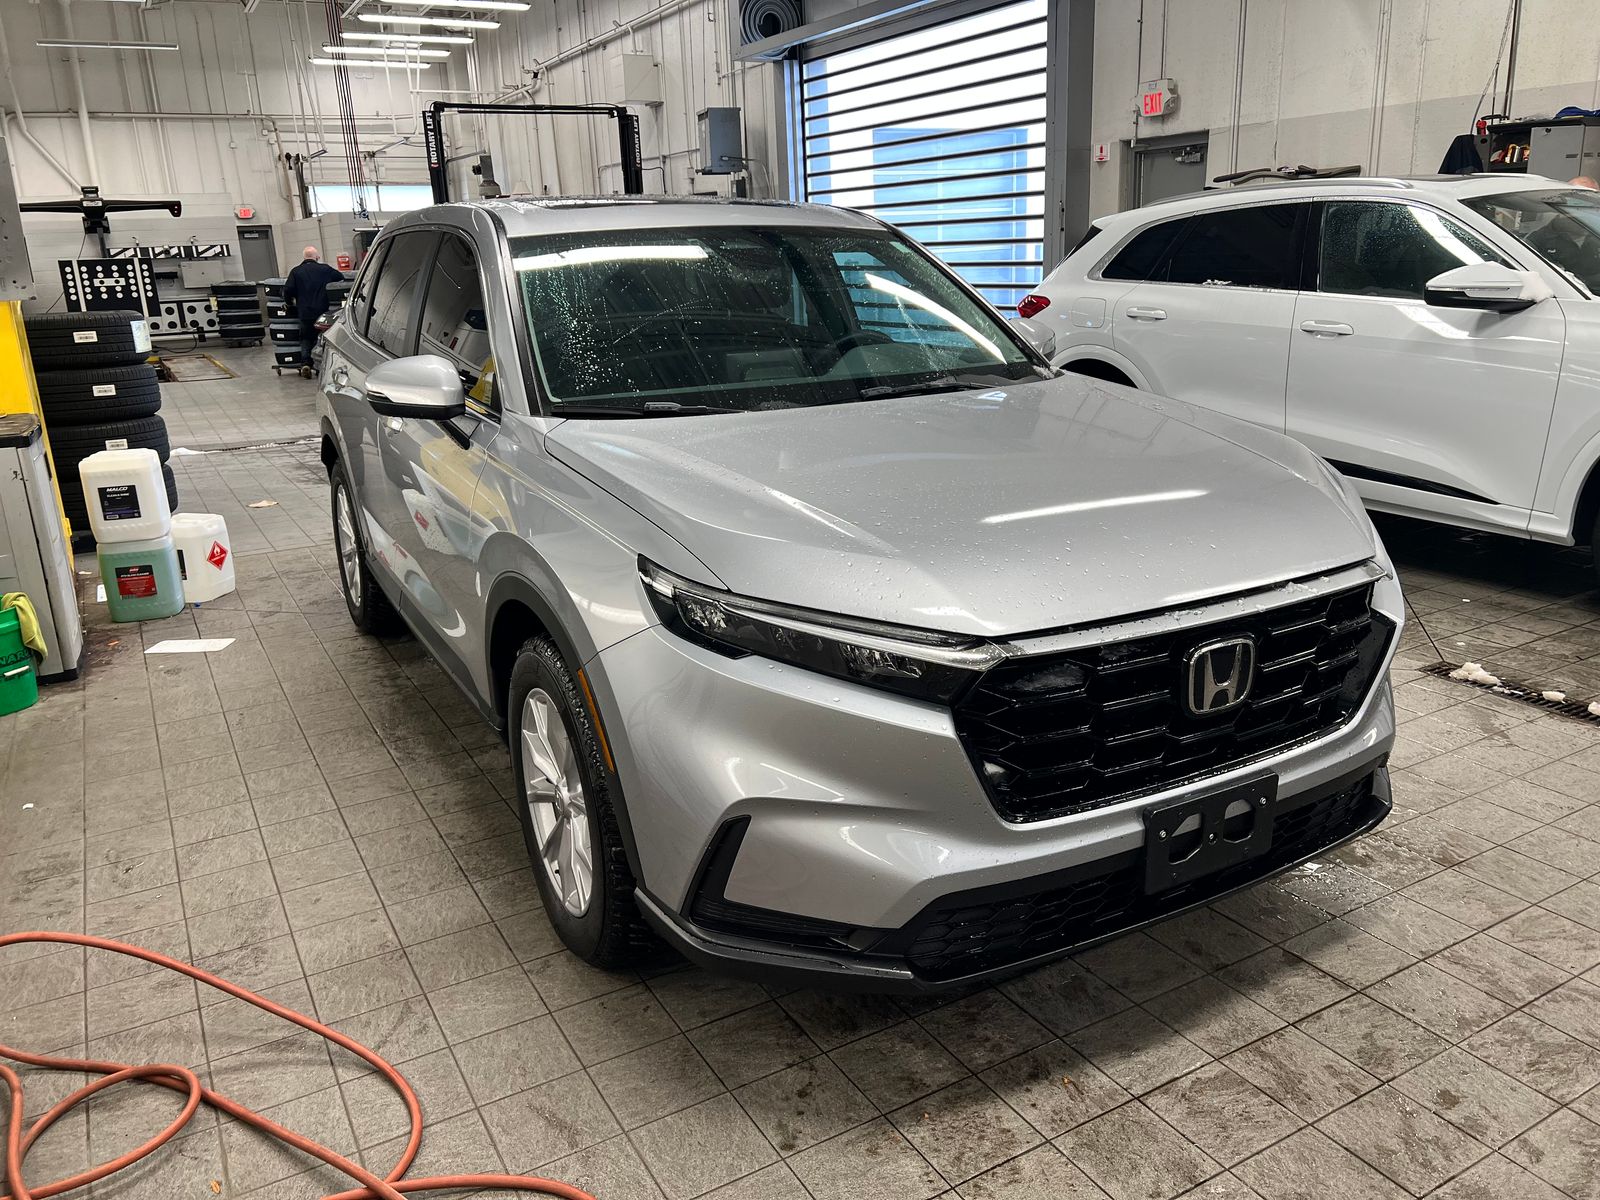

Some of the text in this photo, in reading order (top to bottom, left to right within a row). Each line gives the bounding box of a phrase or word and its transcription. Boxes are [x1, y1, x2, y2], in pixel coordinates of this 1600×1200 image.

[1143, 92, 1163, 115] EXIT
[425, 112, 438, 163] ROTARY LIFT
